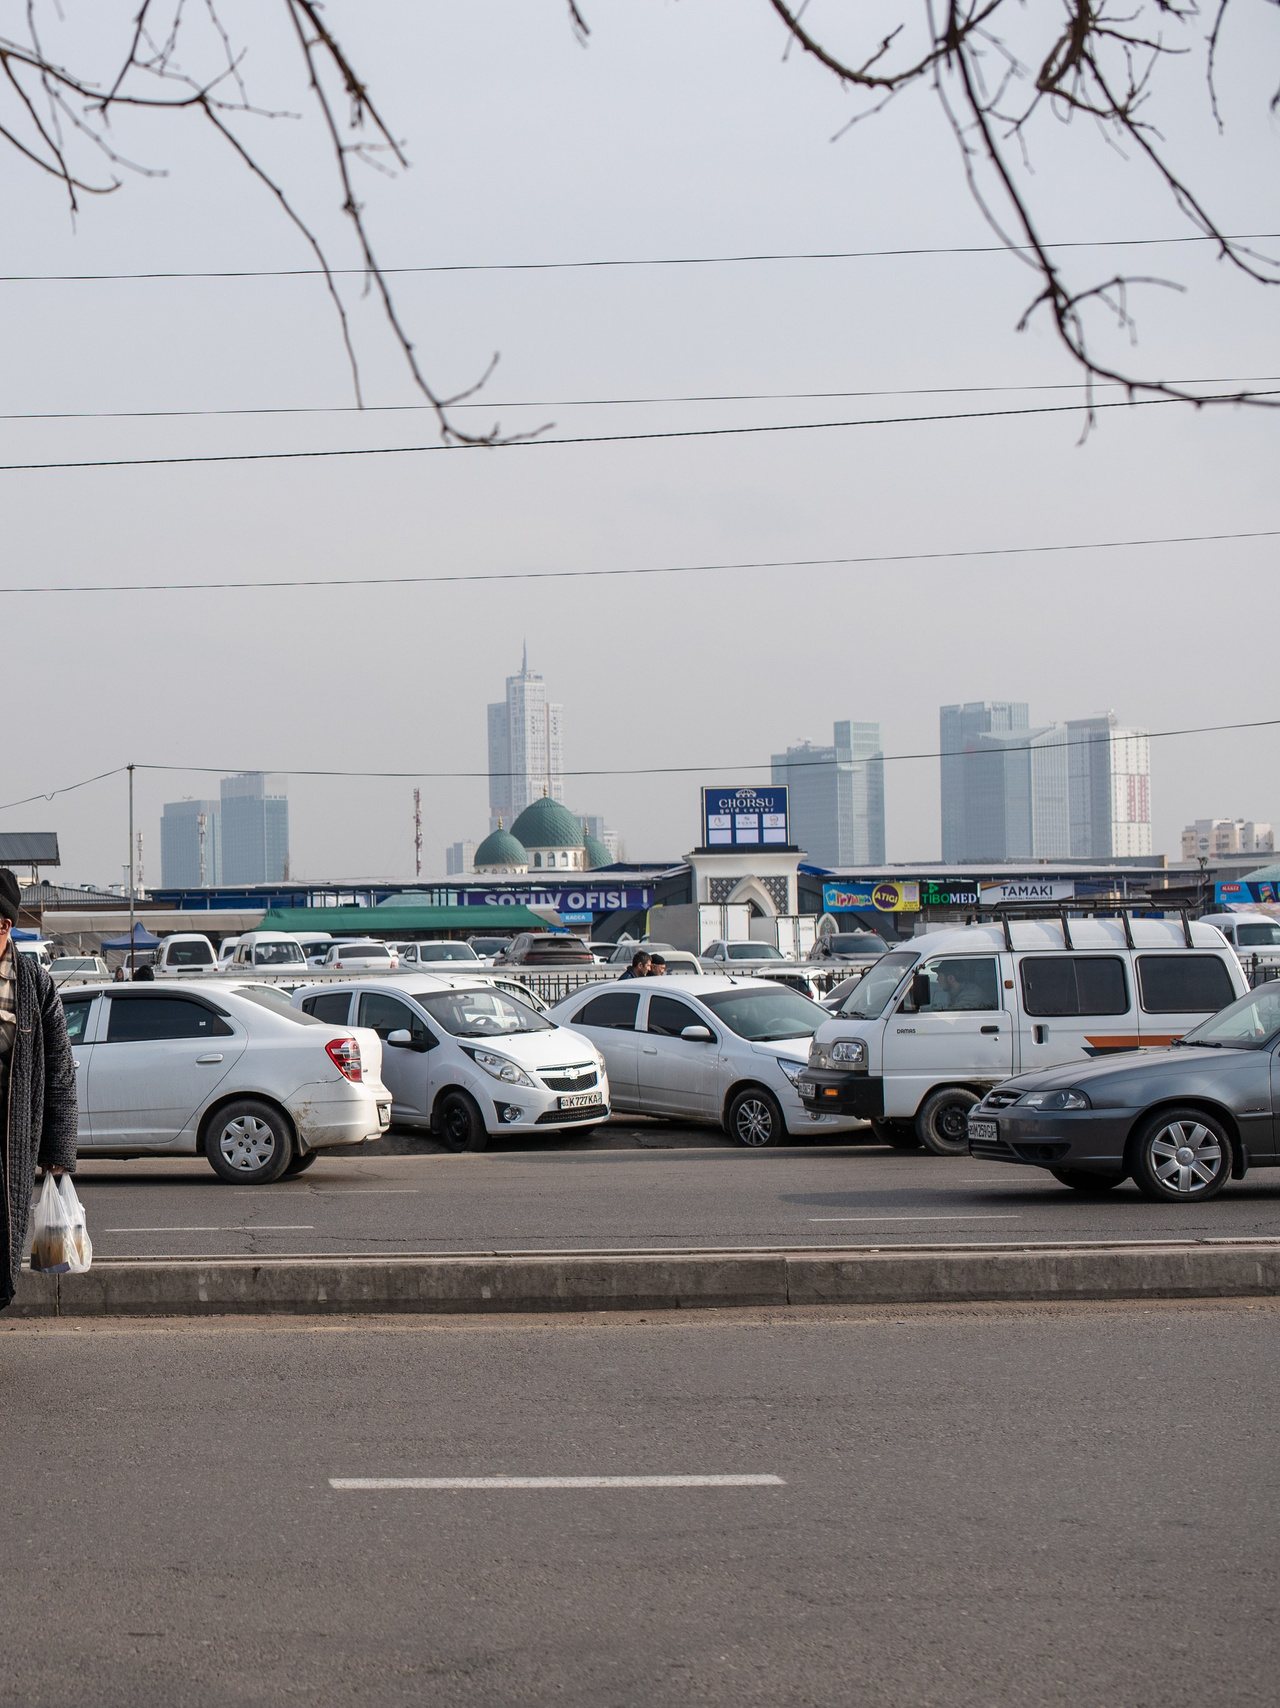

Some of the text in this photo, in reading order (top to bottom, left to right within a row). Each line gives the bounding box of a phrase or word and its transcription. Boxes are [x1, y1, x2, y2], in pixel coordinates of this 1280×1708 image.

[718, 798, 774, 808] CHORSU
[1000, 886, 1053, 896] TAMAKI
[484, 889, 627, 909] SOTUV OFISI
